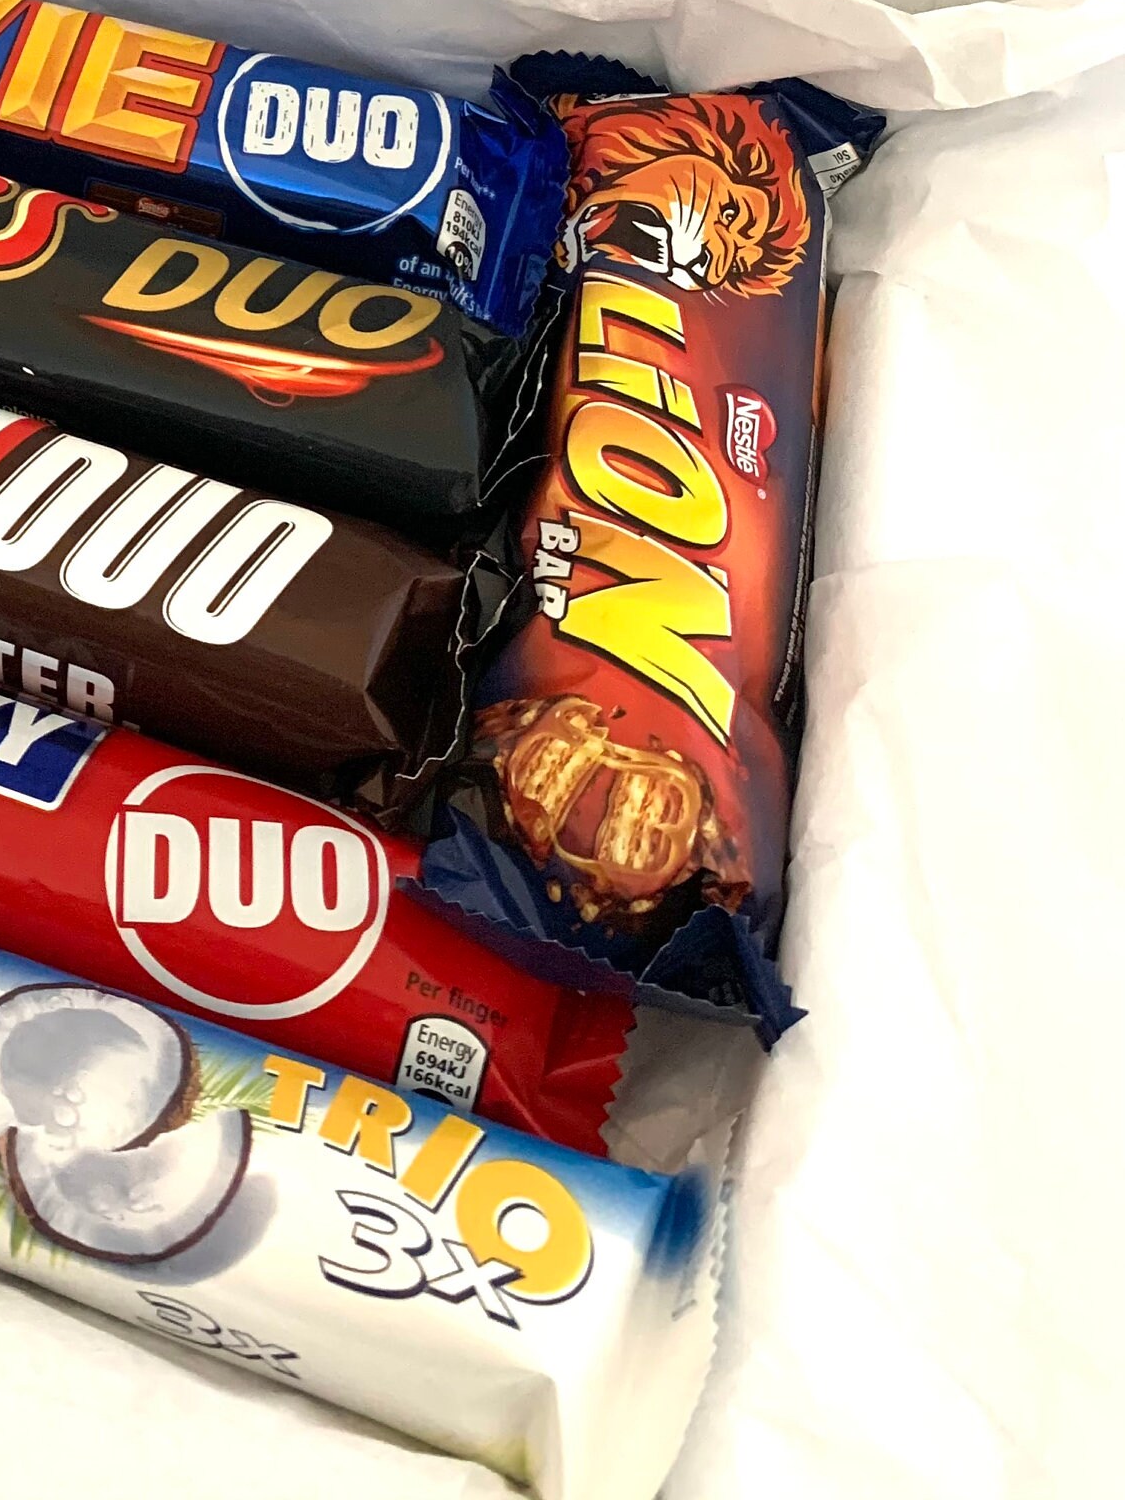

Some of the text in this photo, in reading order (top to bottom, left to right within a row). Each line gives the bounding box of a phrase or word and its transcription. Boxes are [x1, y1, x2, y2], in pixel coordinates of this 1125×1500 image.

[243, 81, 419, 169] DUO
[102, 238, 443, 350] DUO
[399, 256, 419, 273] of
[421, 263, 441, 278] an
[559, 271, 736, 748] LION
[535, 518, 581, 623] BAR
[122, 811, 370, 933] DUO
[406, 971, 508, 1028] Per finger
[417, 1024, 478, 1064] Energy
[405, 1065, 472, 1099] 166kcal
[416, 1051, 467, 1079] 694kJ
[262, 1054, 595, 1307] TRIO
[318, 1190, 521, 1331] 3x
